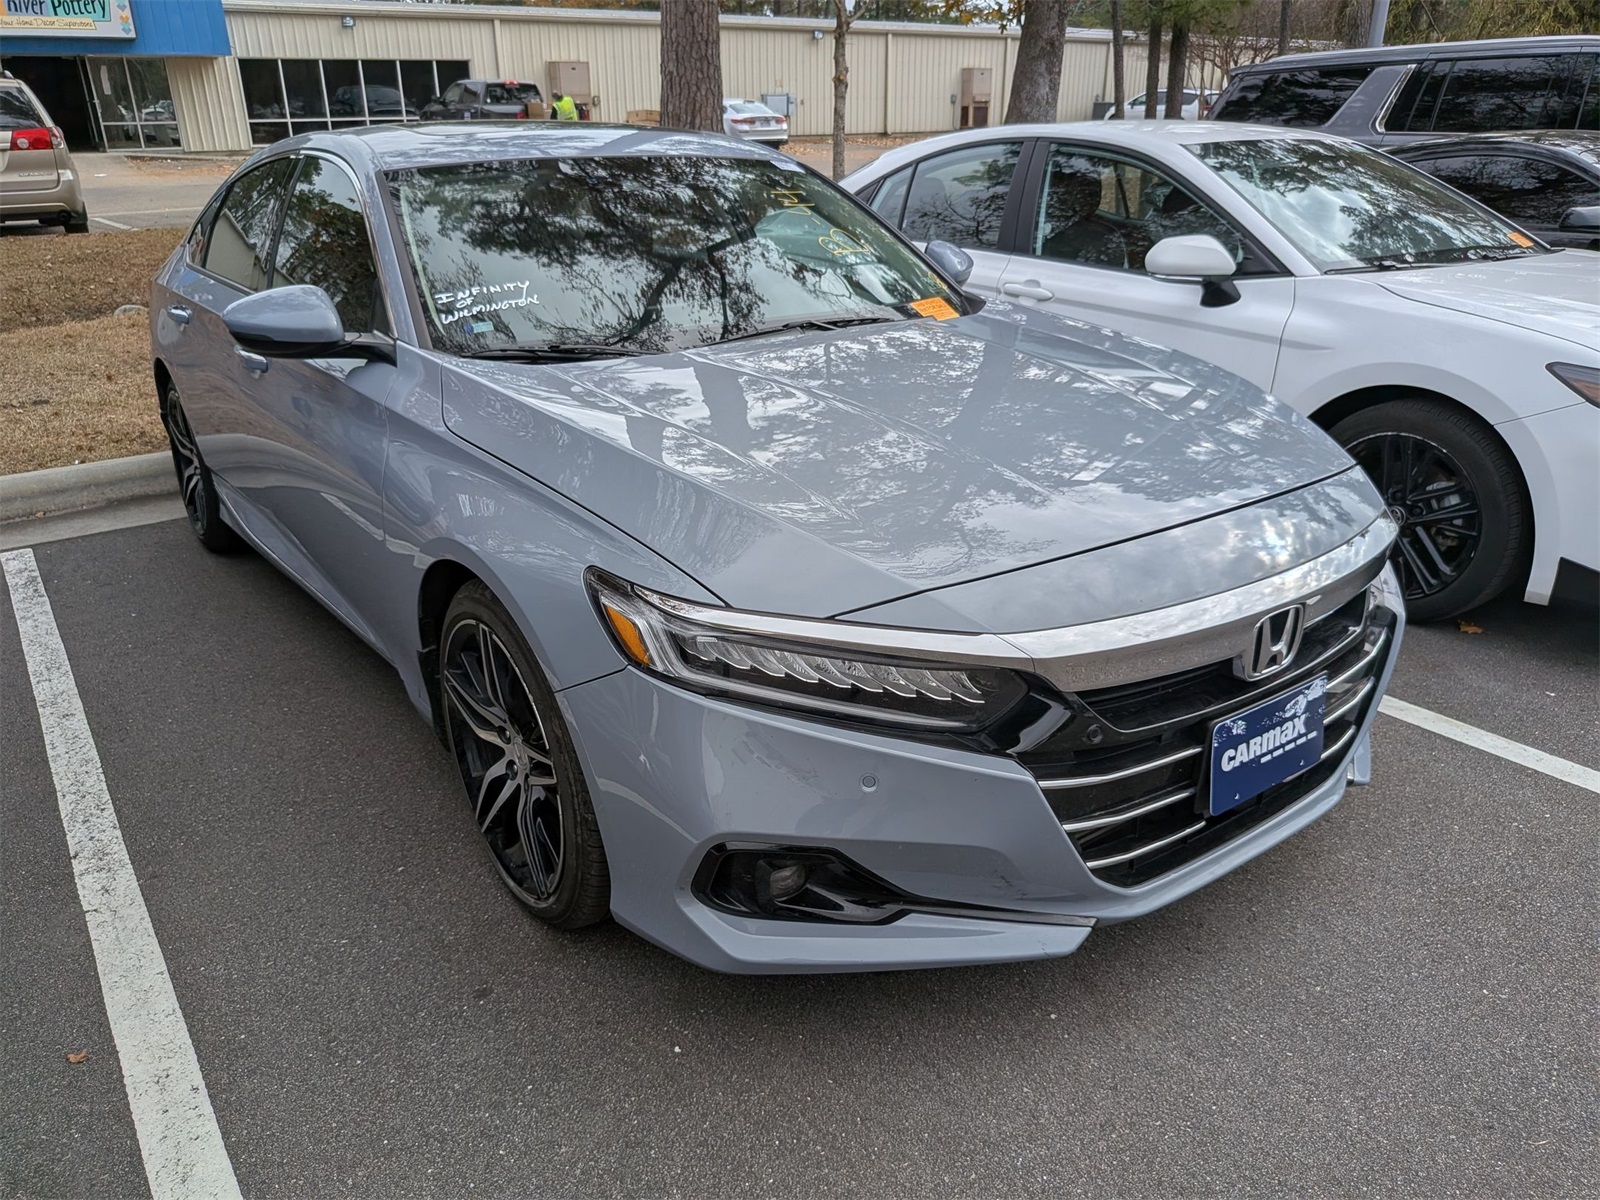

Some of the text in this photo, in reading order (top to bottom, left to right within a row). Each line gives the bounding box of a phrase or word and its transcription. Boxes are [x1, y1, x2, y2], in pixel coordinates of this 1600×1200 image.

[50, 0, 106, 18] Pottery
[434, 280, 530, 304] INFINITY
[456, 296, 475, 309] OF
